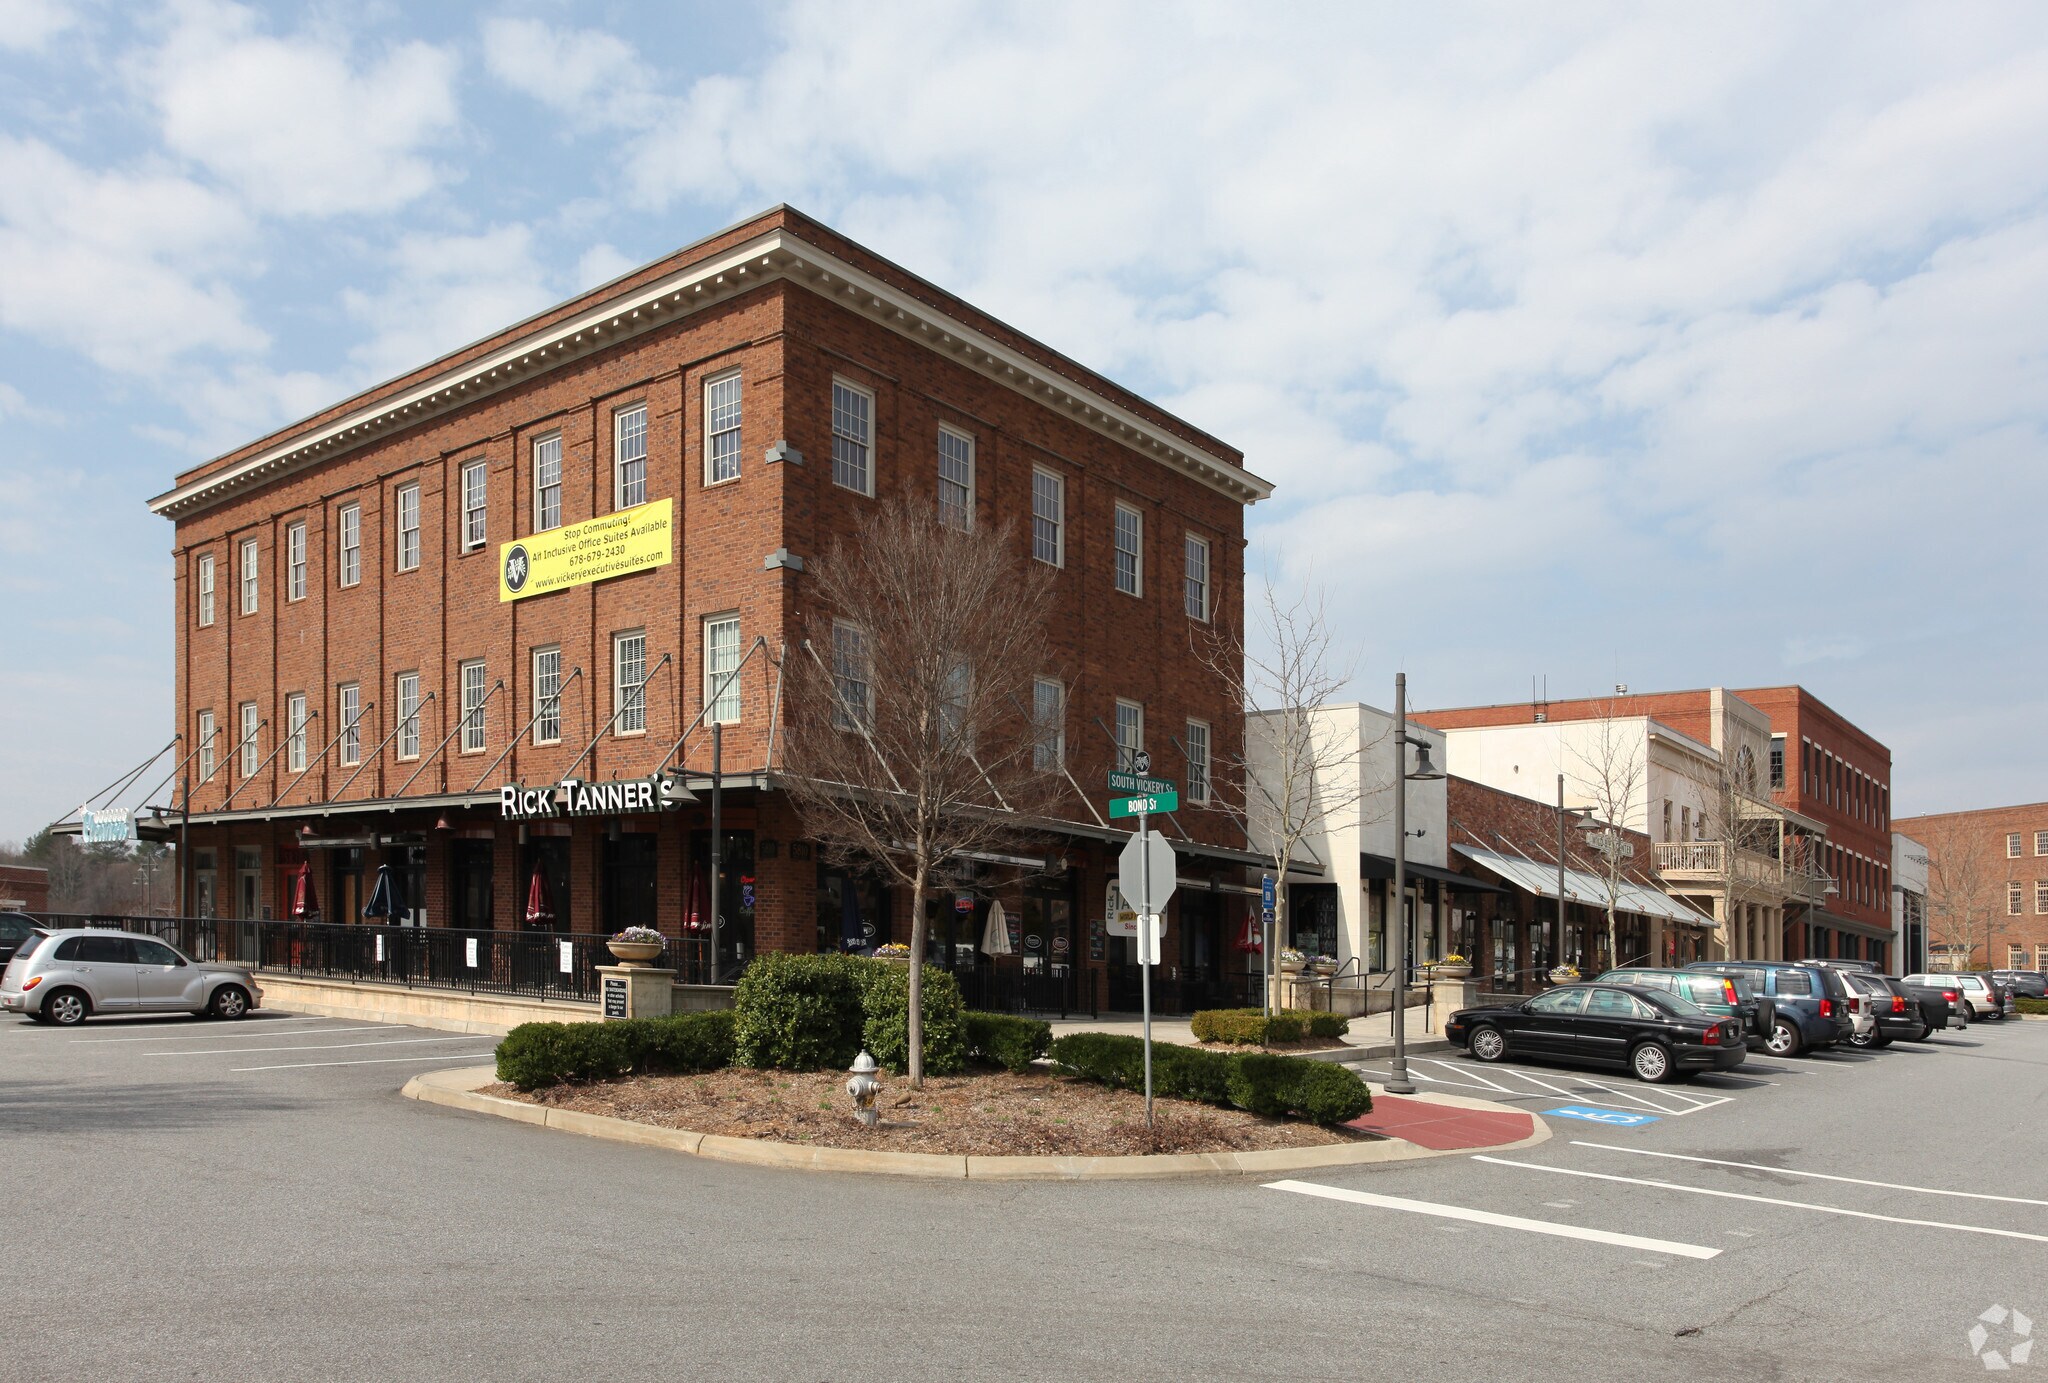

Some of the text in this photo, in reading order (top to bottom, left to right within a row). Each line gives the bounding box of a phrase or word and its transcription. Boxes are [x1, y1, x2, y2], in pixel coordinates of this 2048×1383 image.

[544, 544, 577, 560] Inclusive
[578, 537, 601, 550] Office
[603, 531, 629, 544] Suites
[630, 518, 668, 537] Available
[564, 514, 631, 540] Stop Commuting!
[569, 544, 626, 567] 678-679-2430
[535, 550, 663, 588] www.vickeryexecutivesuites.com
[1111, 774, 1135, 790] SOUTH
[1136, 778, 1165, 794] VICKERY
[1128, 799, 1148, 813] BOND
